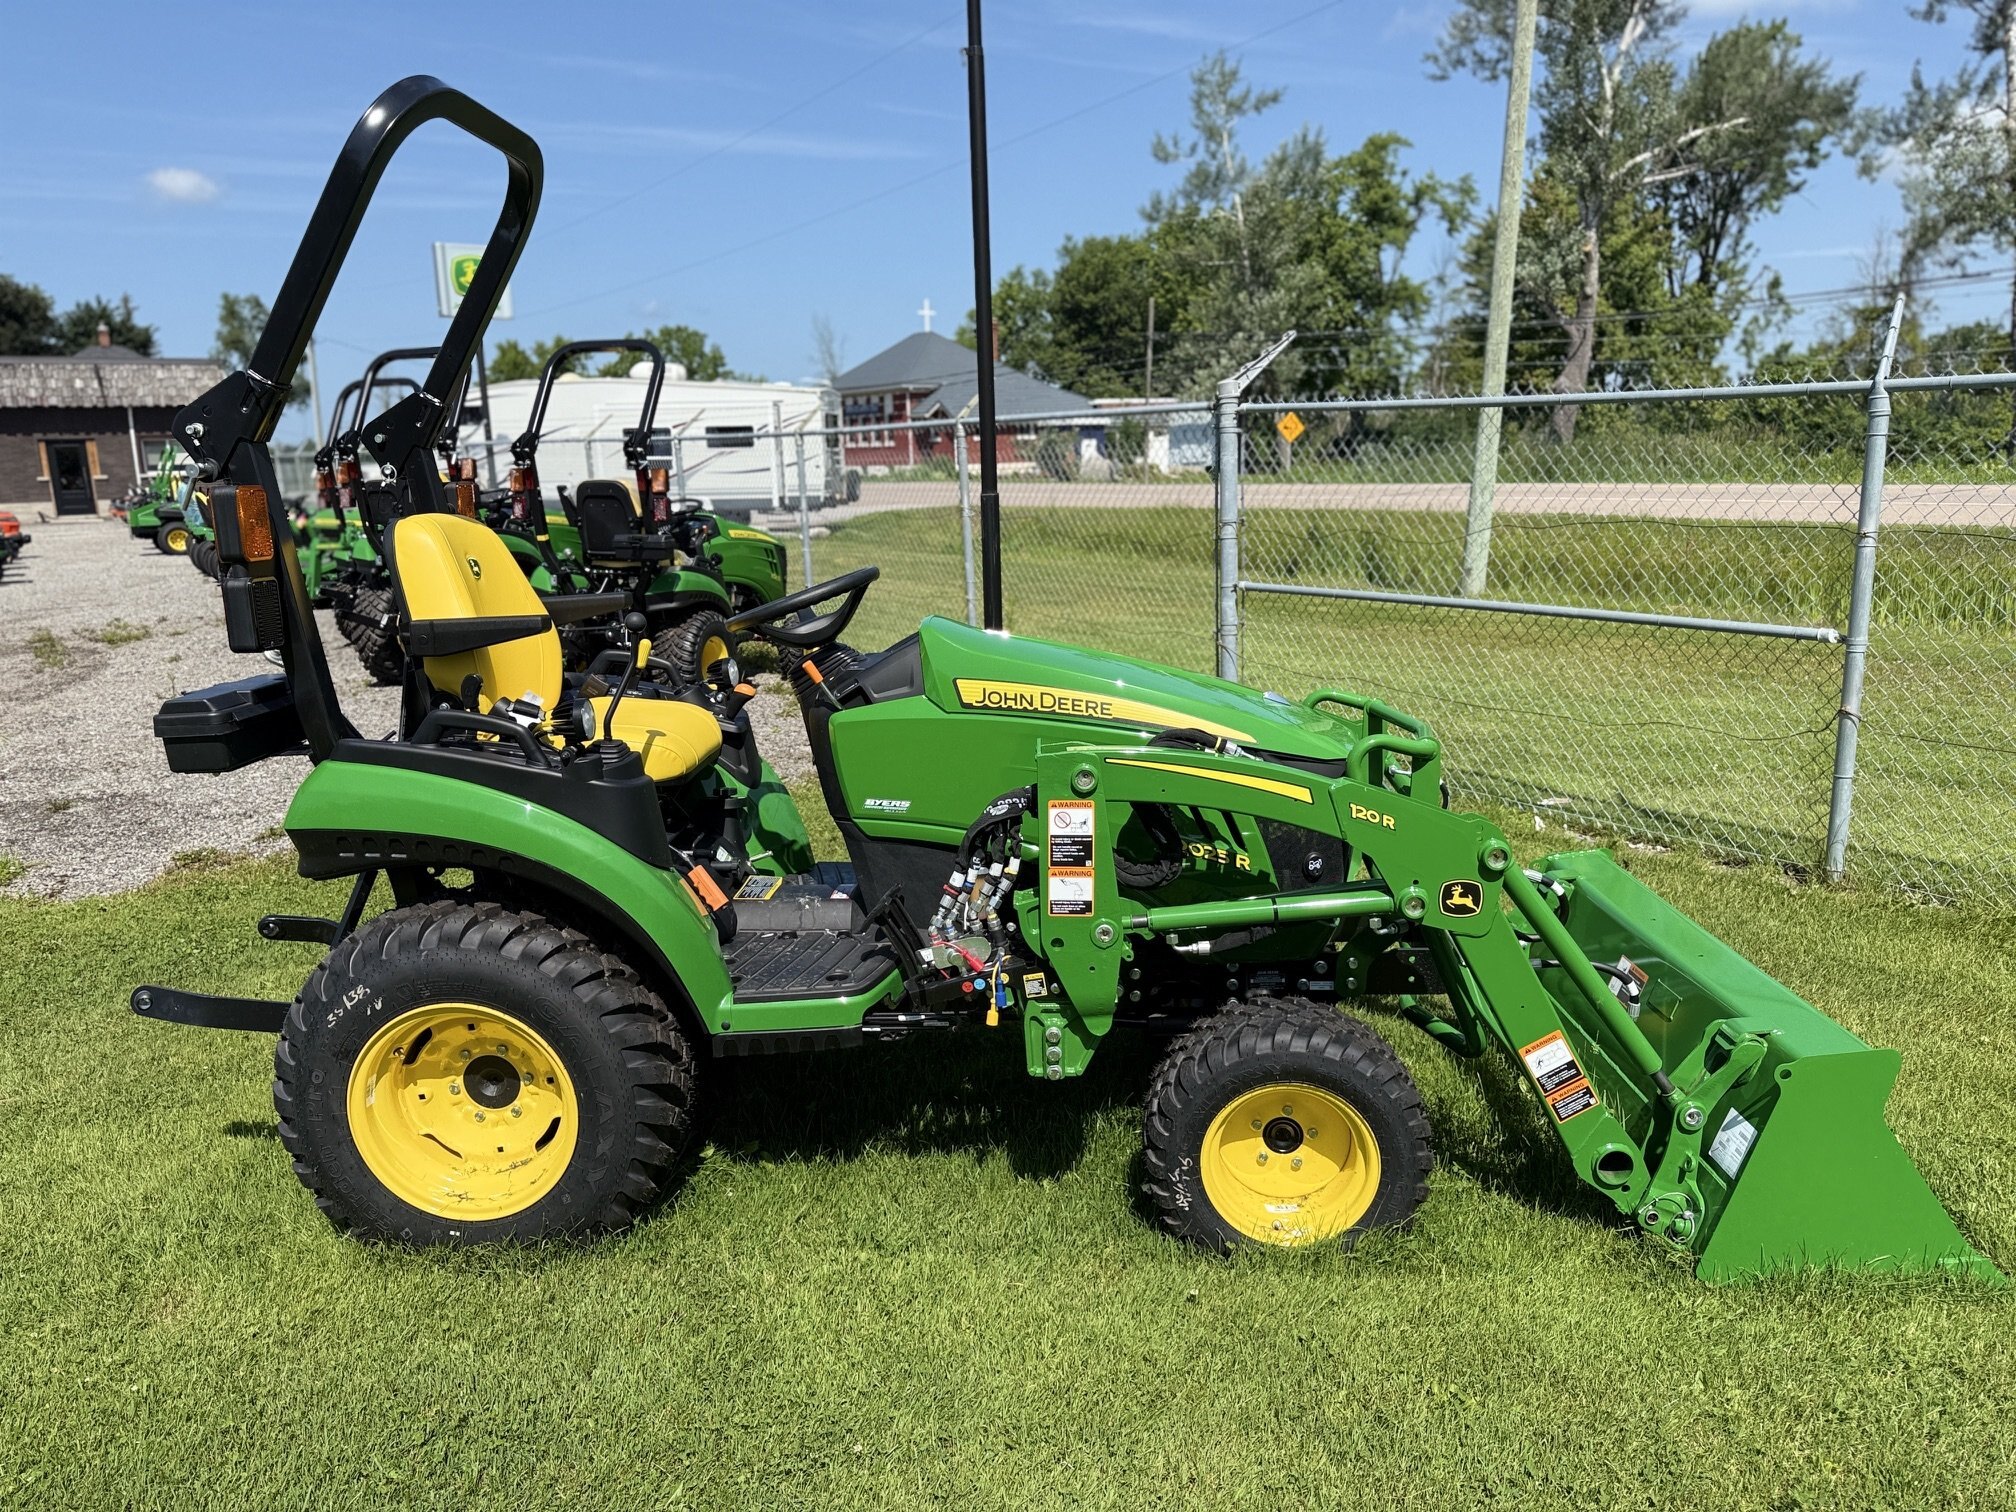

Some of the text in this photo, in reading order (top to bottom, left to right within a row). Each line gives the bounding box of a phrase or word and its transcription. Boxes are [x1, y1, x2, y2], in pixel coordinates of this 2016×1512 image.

[975, 687, 1113, 717] JOHN DEERE
[864, 798, 912, 808] BYERS
[1349, 802, 1396, 830] 120 R
[1235, 853, 1252, 871] R
[1531, 1034, 1558, 1051] WARNING
[533, 996, 616, 1193] GALAXY
[1558, 1082, 1585, 1098] WARNING
